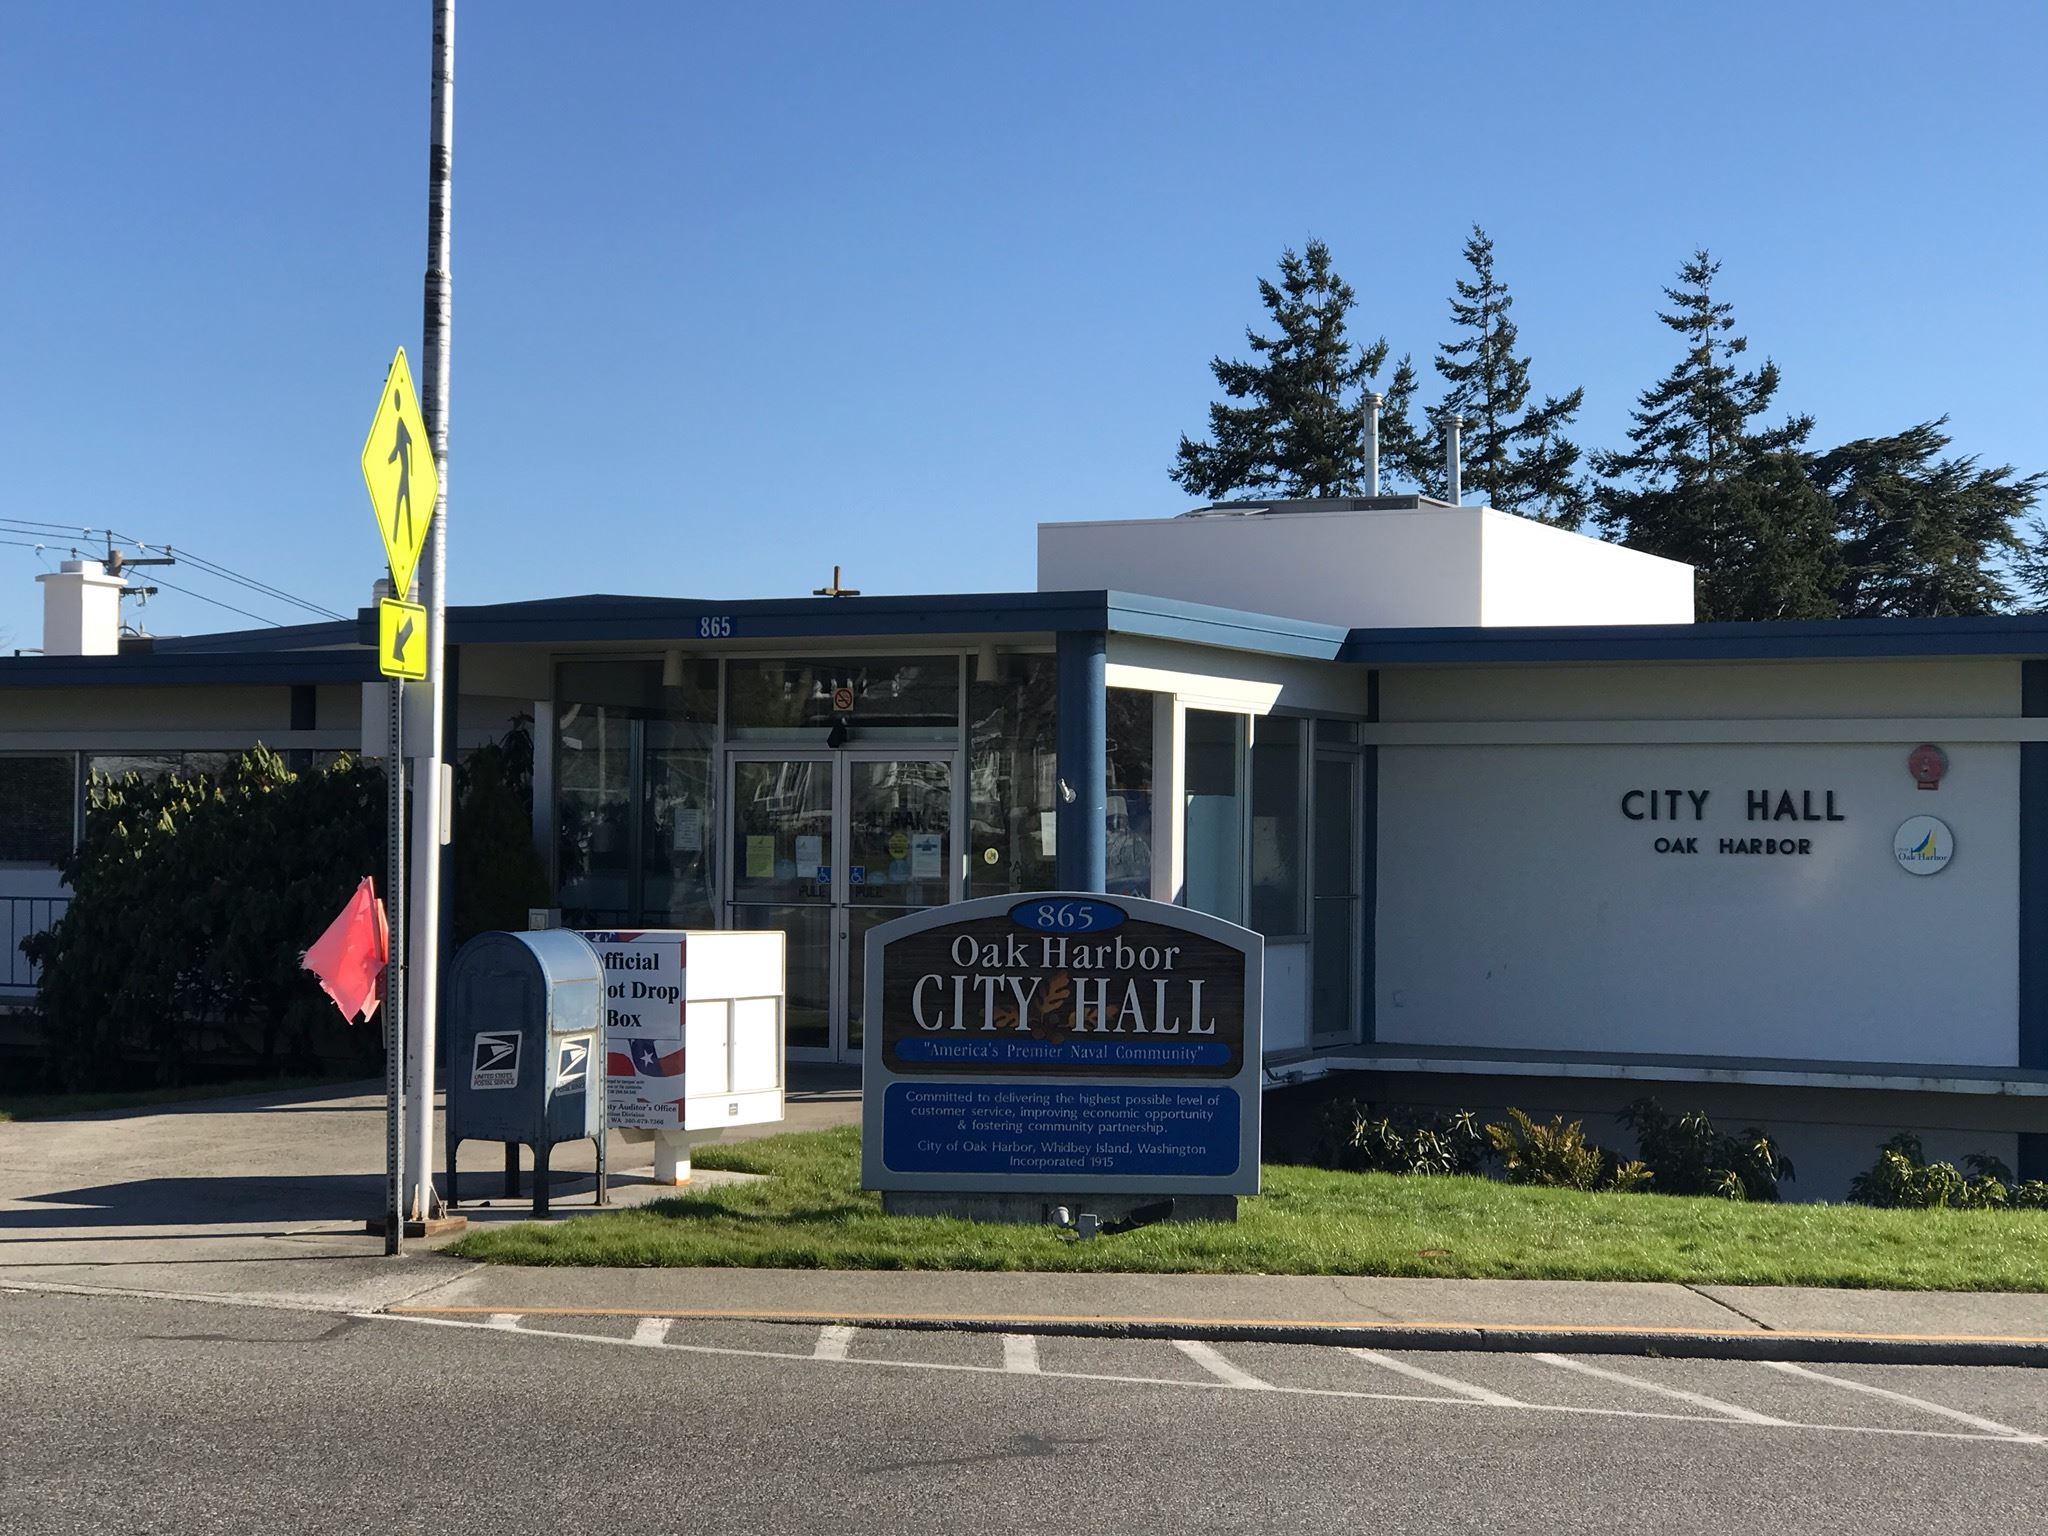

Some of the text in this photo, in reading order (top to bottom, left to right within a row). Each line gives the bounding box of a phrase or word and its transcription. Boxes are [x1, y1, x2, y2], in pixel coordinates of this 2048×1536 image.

[700, 616, 731, 637] 865
[1622, 790, 1844, 821] CITY HALL
[1654, 838, 1810, 855] OAK HARBOR
[1038, 903, 1092, 929] 865
[952, 934, 1180, 969] Oak Harbor
[632, 982, 680, 1004] Drop
[913, 974, 1215, 1035] CITY HALL
[607, 1009, 642, 1028] Box
[925, 1042, 1203, 1063] "America's Premier Naval Community"
[619, 1103, 652, 1111] Auditor's
[654, 1104, 677, 1112] Office
[906, 1091, 972, 1102] Committed
[995, 1092, 1049, 1107] delivering
[1056, 1092, 1074, 1103] the
[1080, 1093, 1120, 1106] highest
[1126, 1094, 1171, 1107] possible
[1177, 1095, 1202, 1105] level
[1208, 1095, 1219, 1105] of
[912, 1106, 1213, 1123] customer service, improving economic opportunity
[958, 1120, 1167, 1135] & fostering community partnership.
[918, 1141, 1206, 1157] City of Oak Harbor, Whidbey Island, Washington
[1010, 1156, 1113, 1168] Incorporated 1915
